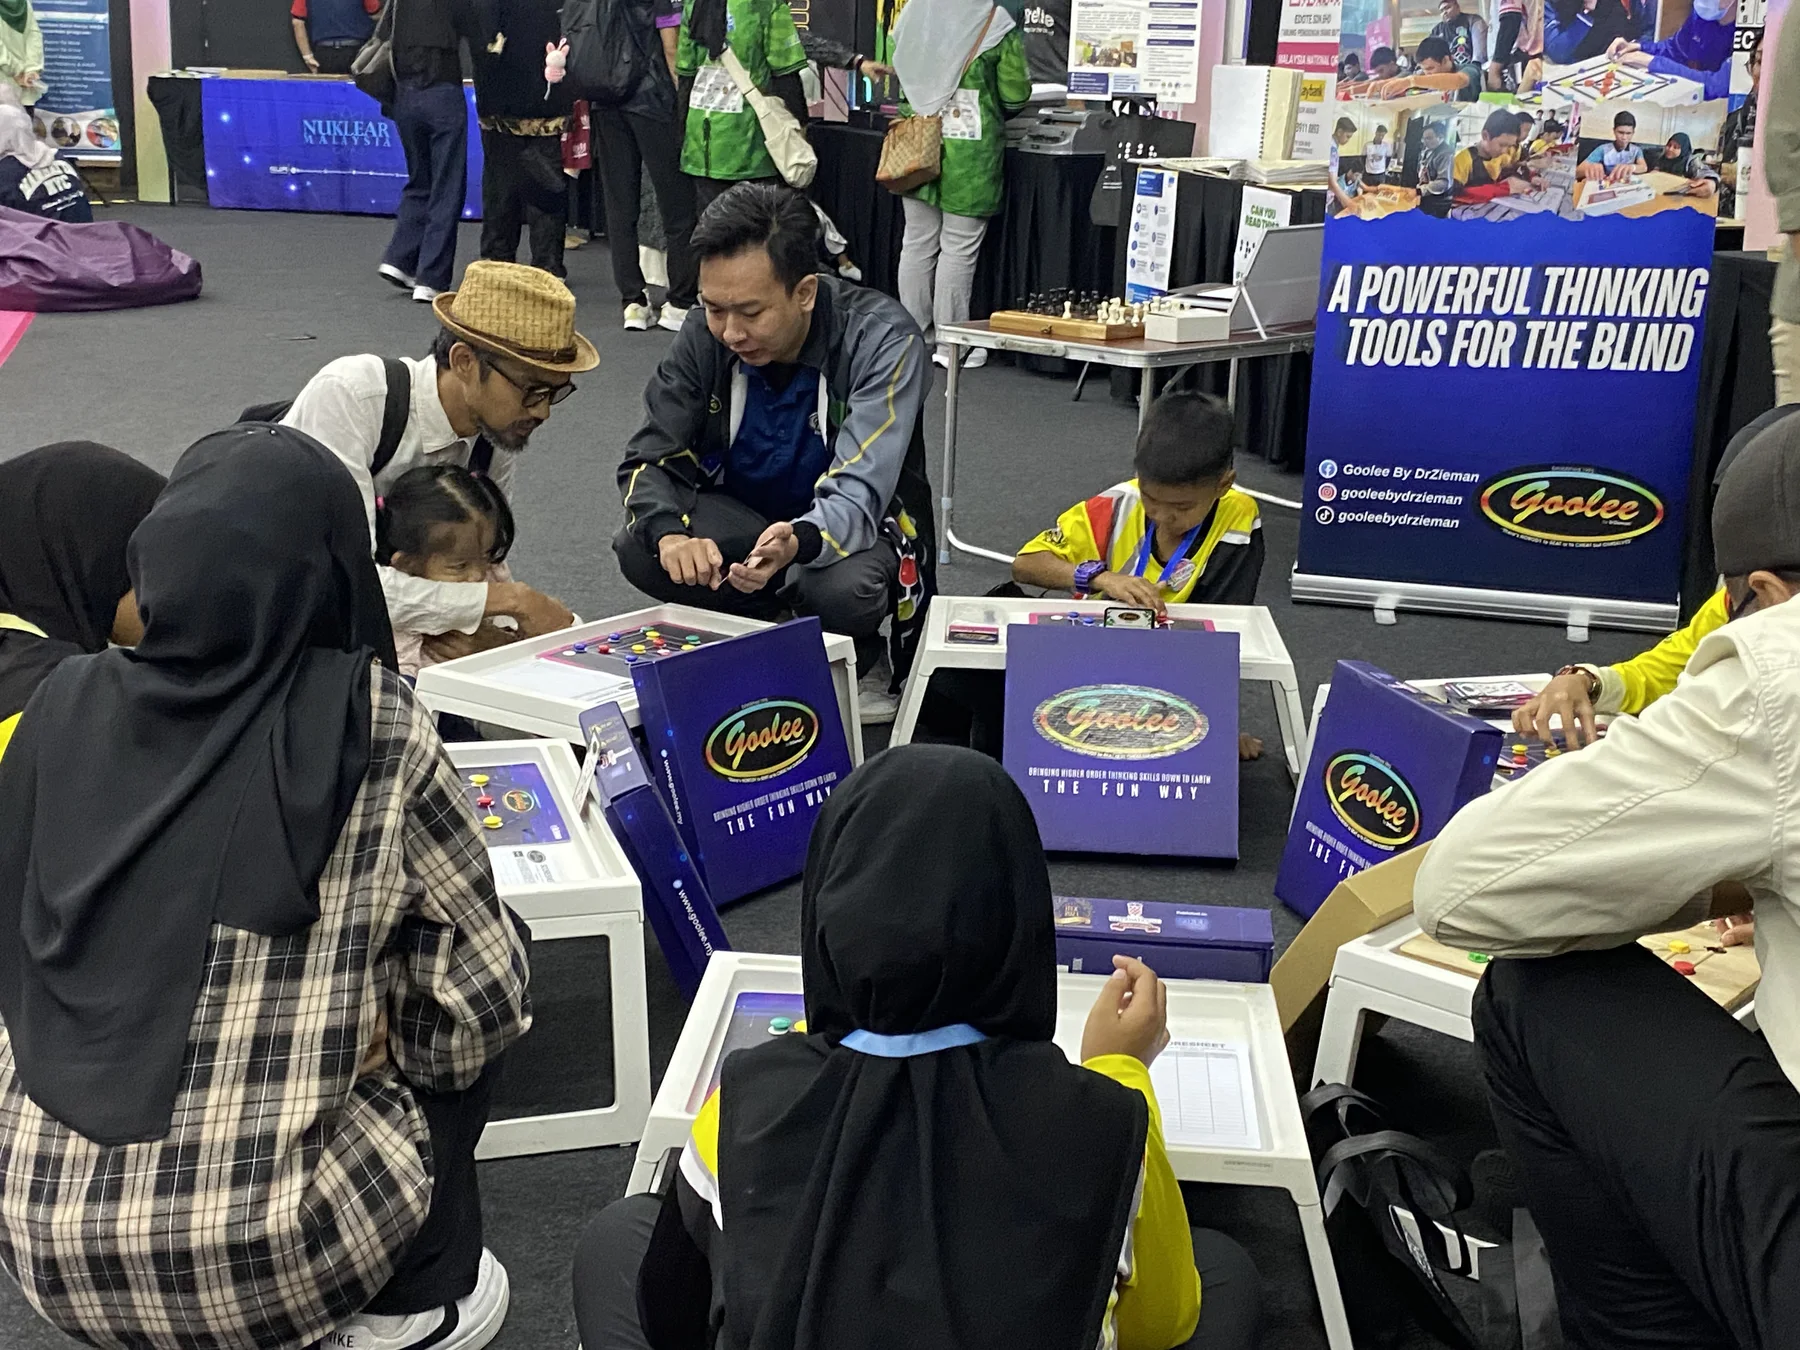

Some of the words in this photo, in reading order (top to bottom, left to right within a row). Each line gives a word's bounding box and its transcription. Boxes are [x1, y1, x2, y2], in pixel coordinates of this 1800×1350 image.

[1301, 84, 1323, 100] aybank
[303, 119, 390, 138] NUKLEAR
[303, 135, 391, 147] MALAYSIA
[1245, 215, 1261, 228] READ
[1251, 204, 1264, 216] CAN
[1264, 207, 1277, 220] YOU
[1327, 265, 1353, 313] A
[1356, 265, 1532, 316] POWERFUL
[1541, 266, 1709, 318] THINKING
[1345, 318, 1447, 367] TOOLS
[1448, 319, 1517, 369] FOR
[1521, 320, 1588, 370] THE
[1586, 322, 1695, 372] BLIND
[1343, 463, 1390, 477] Goolee
[1392, 466, 1412, 481] By
[1414, 467, 1480, 483] DrZieman
[1340, 488, 1463, 505] gooleebydrzieman
[1510, 480, 1639, 524] Goolee
[1338, 511, 1460, 528] gooleebydrzieman
[1066, 699, 1180, 738] Goolee
[725, 712, 804, 770] Goolee
[1028, 767, 1060, 777] BRINGING
[1060, 768, 1085, 778] HIGHER
[1086, 769, 1107, 779] ORDER
[1108, 770, 1138, 781] THINKING
[1139, 772, 1160, 782] SKILLS
[1161, 773, 1181, 783] DOWN
[1182, 774, 1190, 783] TO
[1191, 774, 1211, 784] EARTH
[663, 759, 683, 825] www.goolee.my
[1043, 779, 1080, 795] THE
[1102, 782, 1139, 797] FUN
[1159, 785, 1198, 800] WAY
[1338, 764, 1407, 826] Goolee
[727, 813, 755, 835] THE
[768, 799, 795, 821] FUN
[805, 785, 831, 807] WAY
[1309, 838, 1331, 864] THE
[678, 889, 714, 956] www.goolee.my
